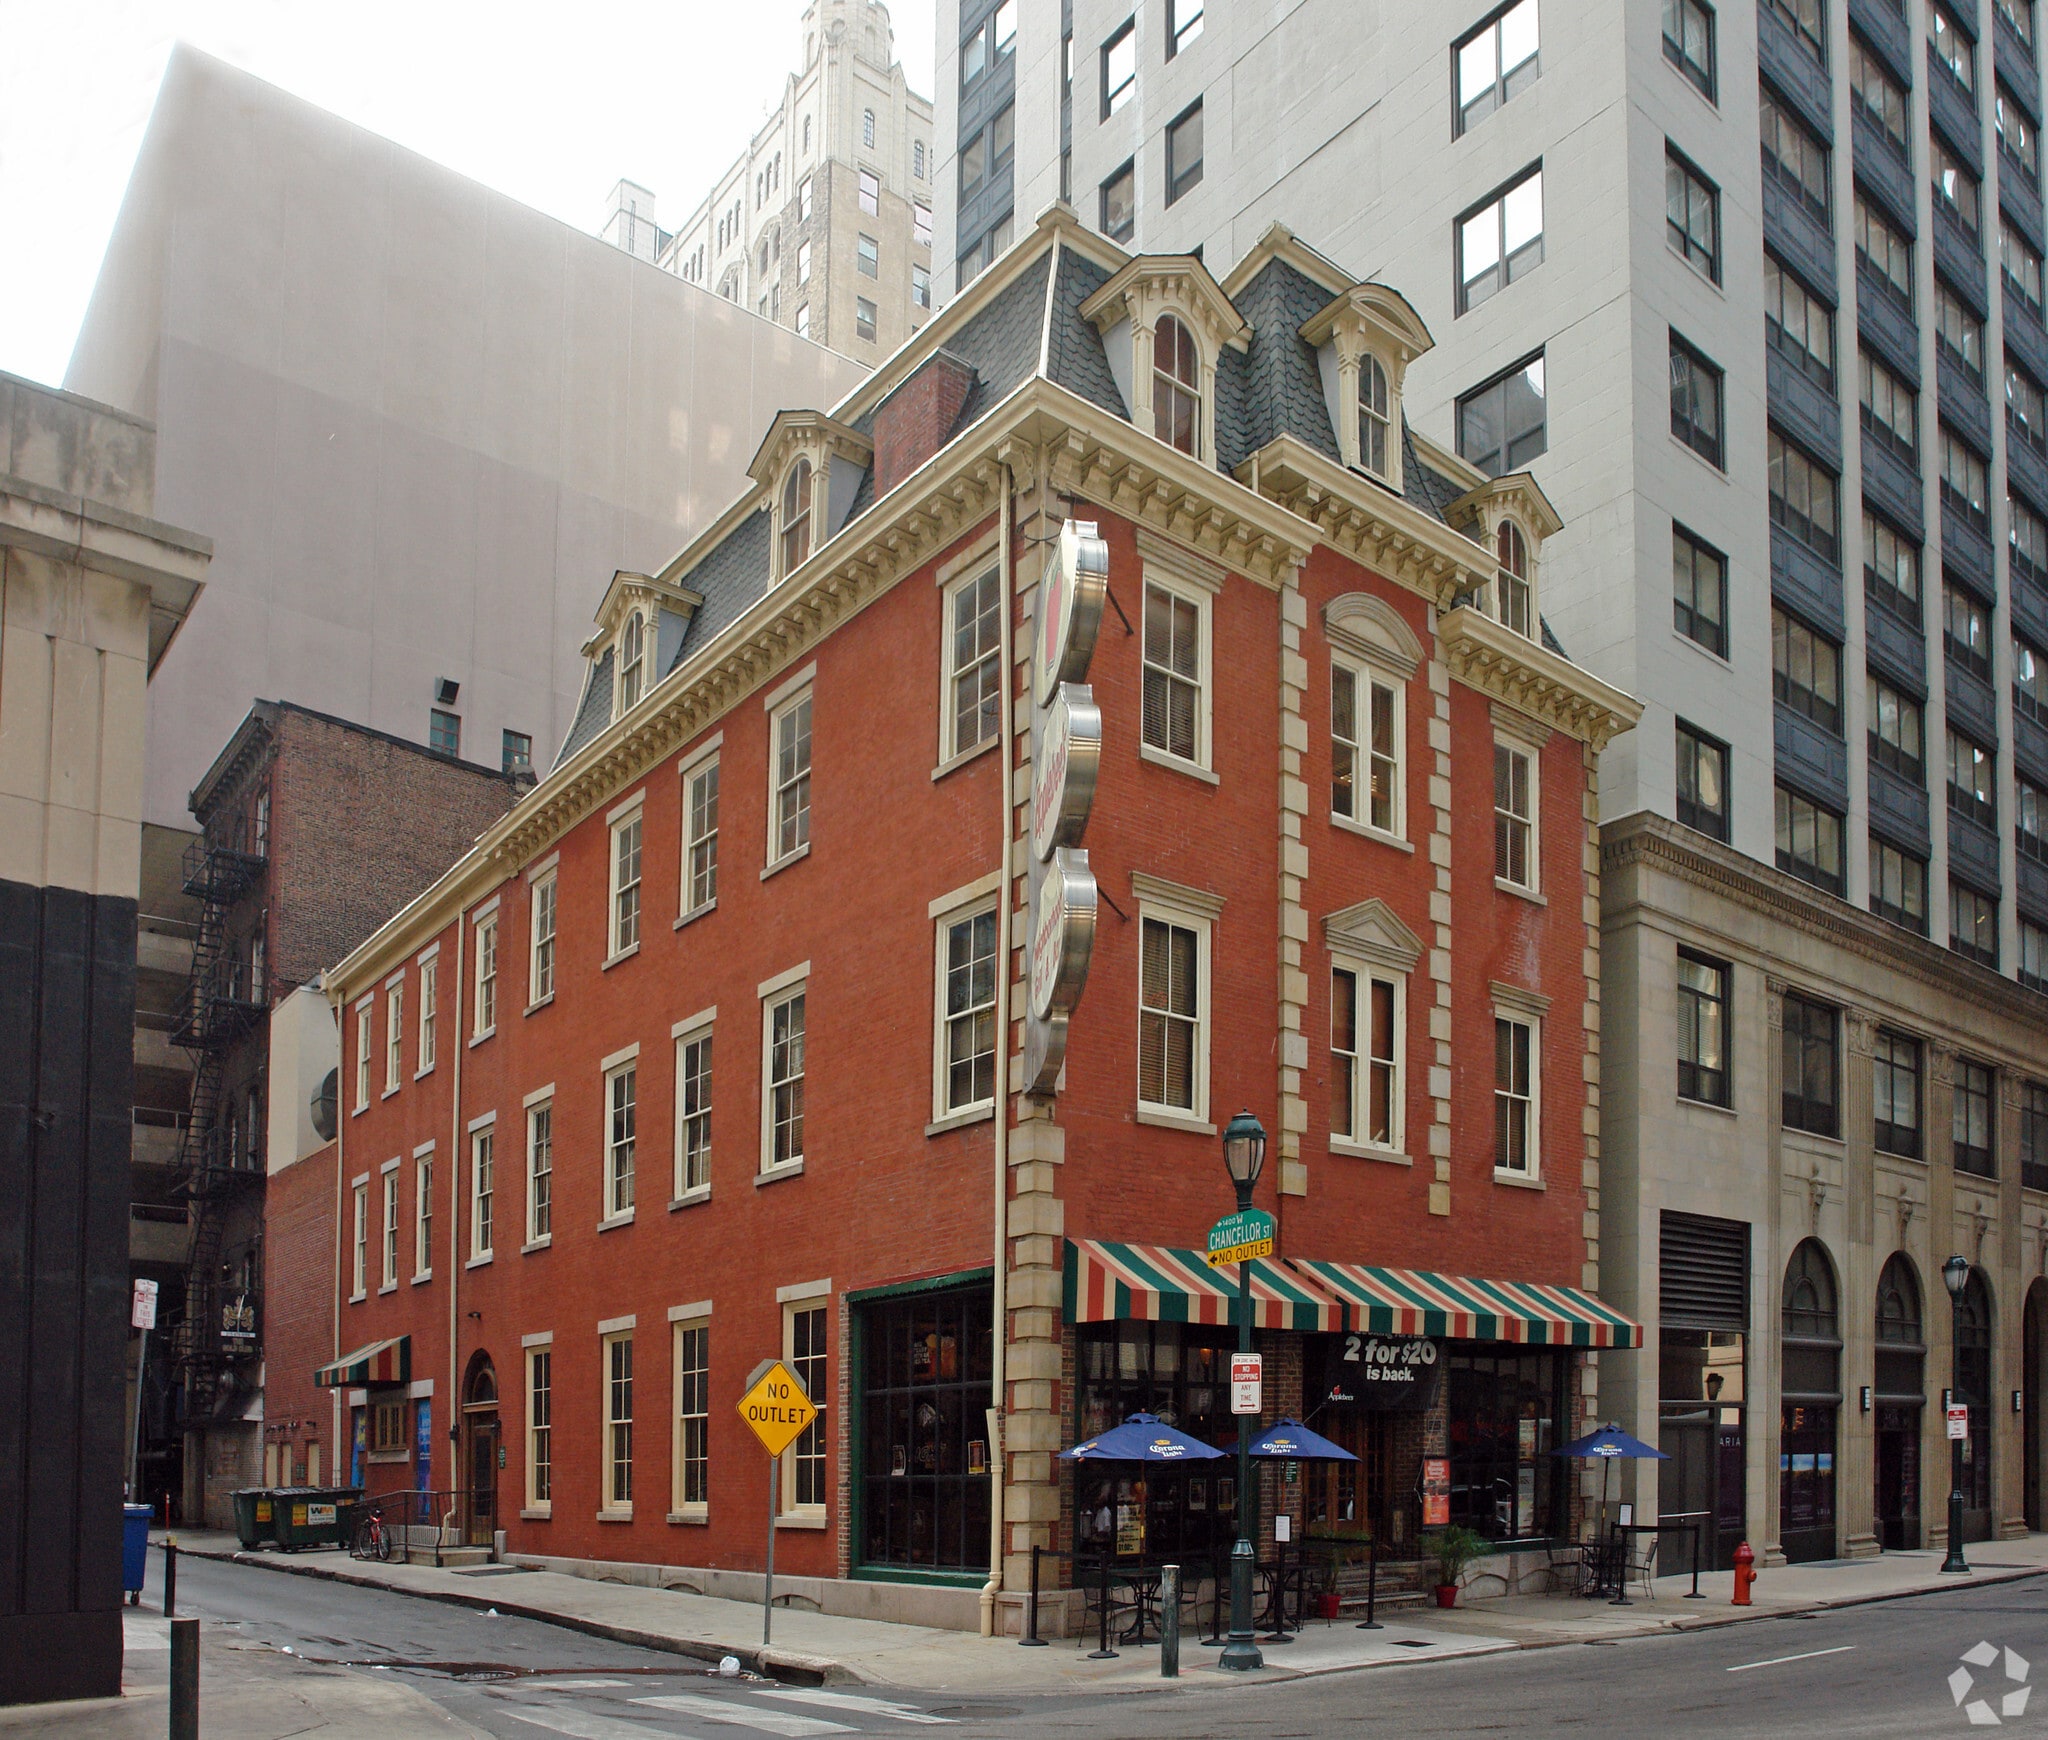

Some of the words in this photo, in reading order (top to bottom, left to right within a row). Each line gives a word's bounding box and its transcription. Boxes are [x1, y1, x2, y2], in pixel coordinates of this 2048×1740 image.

[1237, 1214, 1244, 1224] W
[1209, 1221, 1261, 1250] CHANCELLOR
[1263, 1225, 1270, 1238] ST
[1219, 1250, 1233, 1263] NO
[1235, 1240, 1271, 1260] OUTLET
[1343, 1336, 1361, 1362] 2
[1365, 1339, 1400, 1364] for
[1401, 1341, 1437, 1365] $20
[1234, 1373, 1259, 1381] STOPPING
[1242, 1365, 1251, 1373] NO
[1366, 1365, 1380, 1380] is
[1382, 1366, 1415, 1382] back.
[768, 1382, 789, 1399] NO
[1241, 1394, 1252, 1402] TIME
[749, 1405, 806, 1424] OUTLET
[1149, 1445, 1186, 1453] Corona
